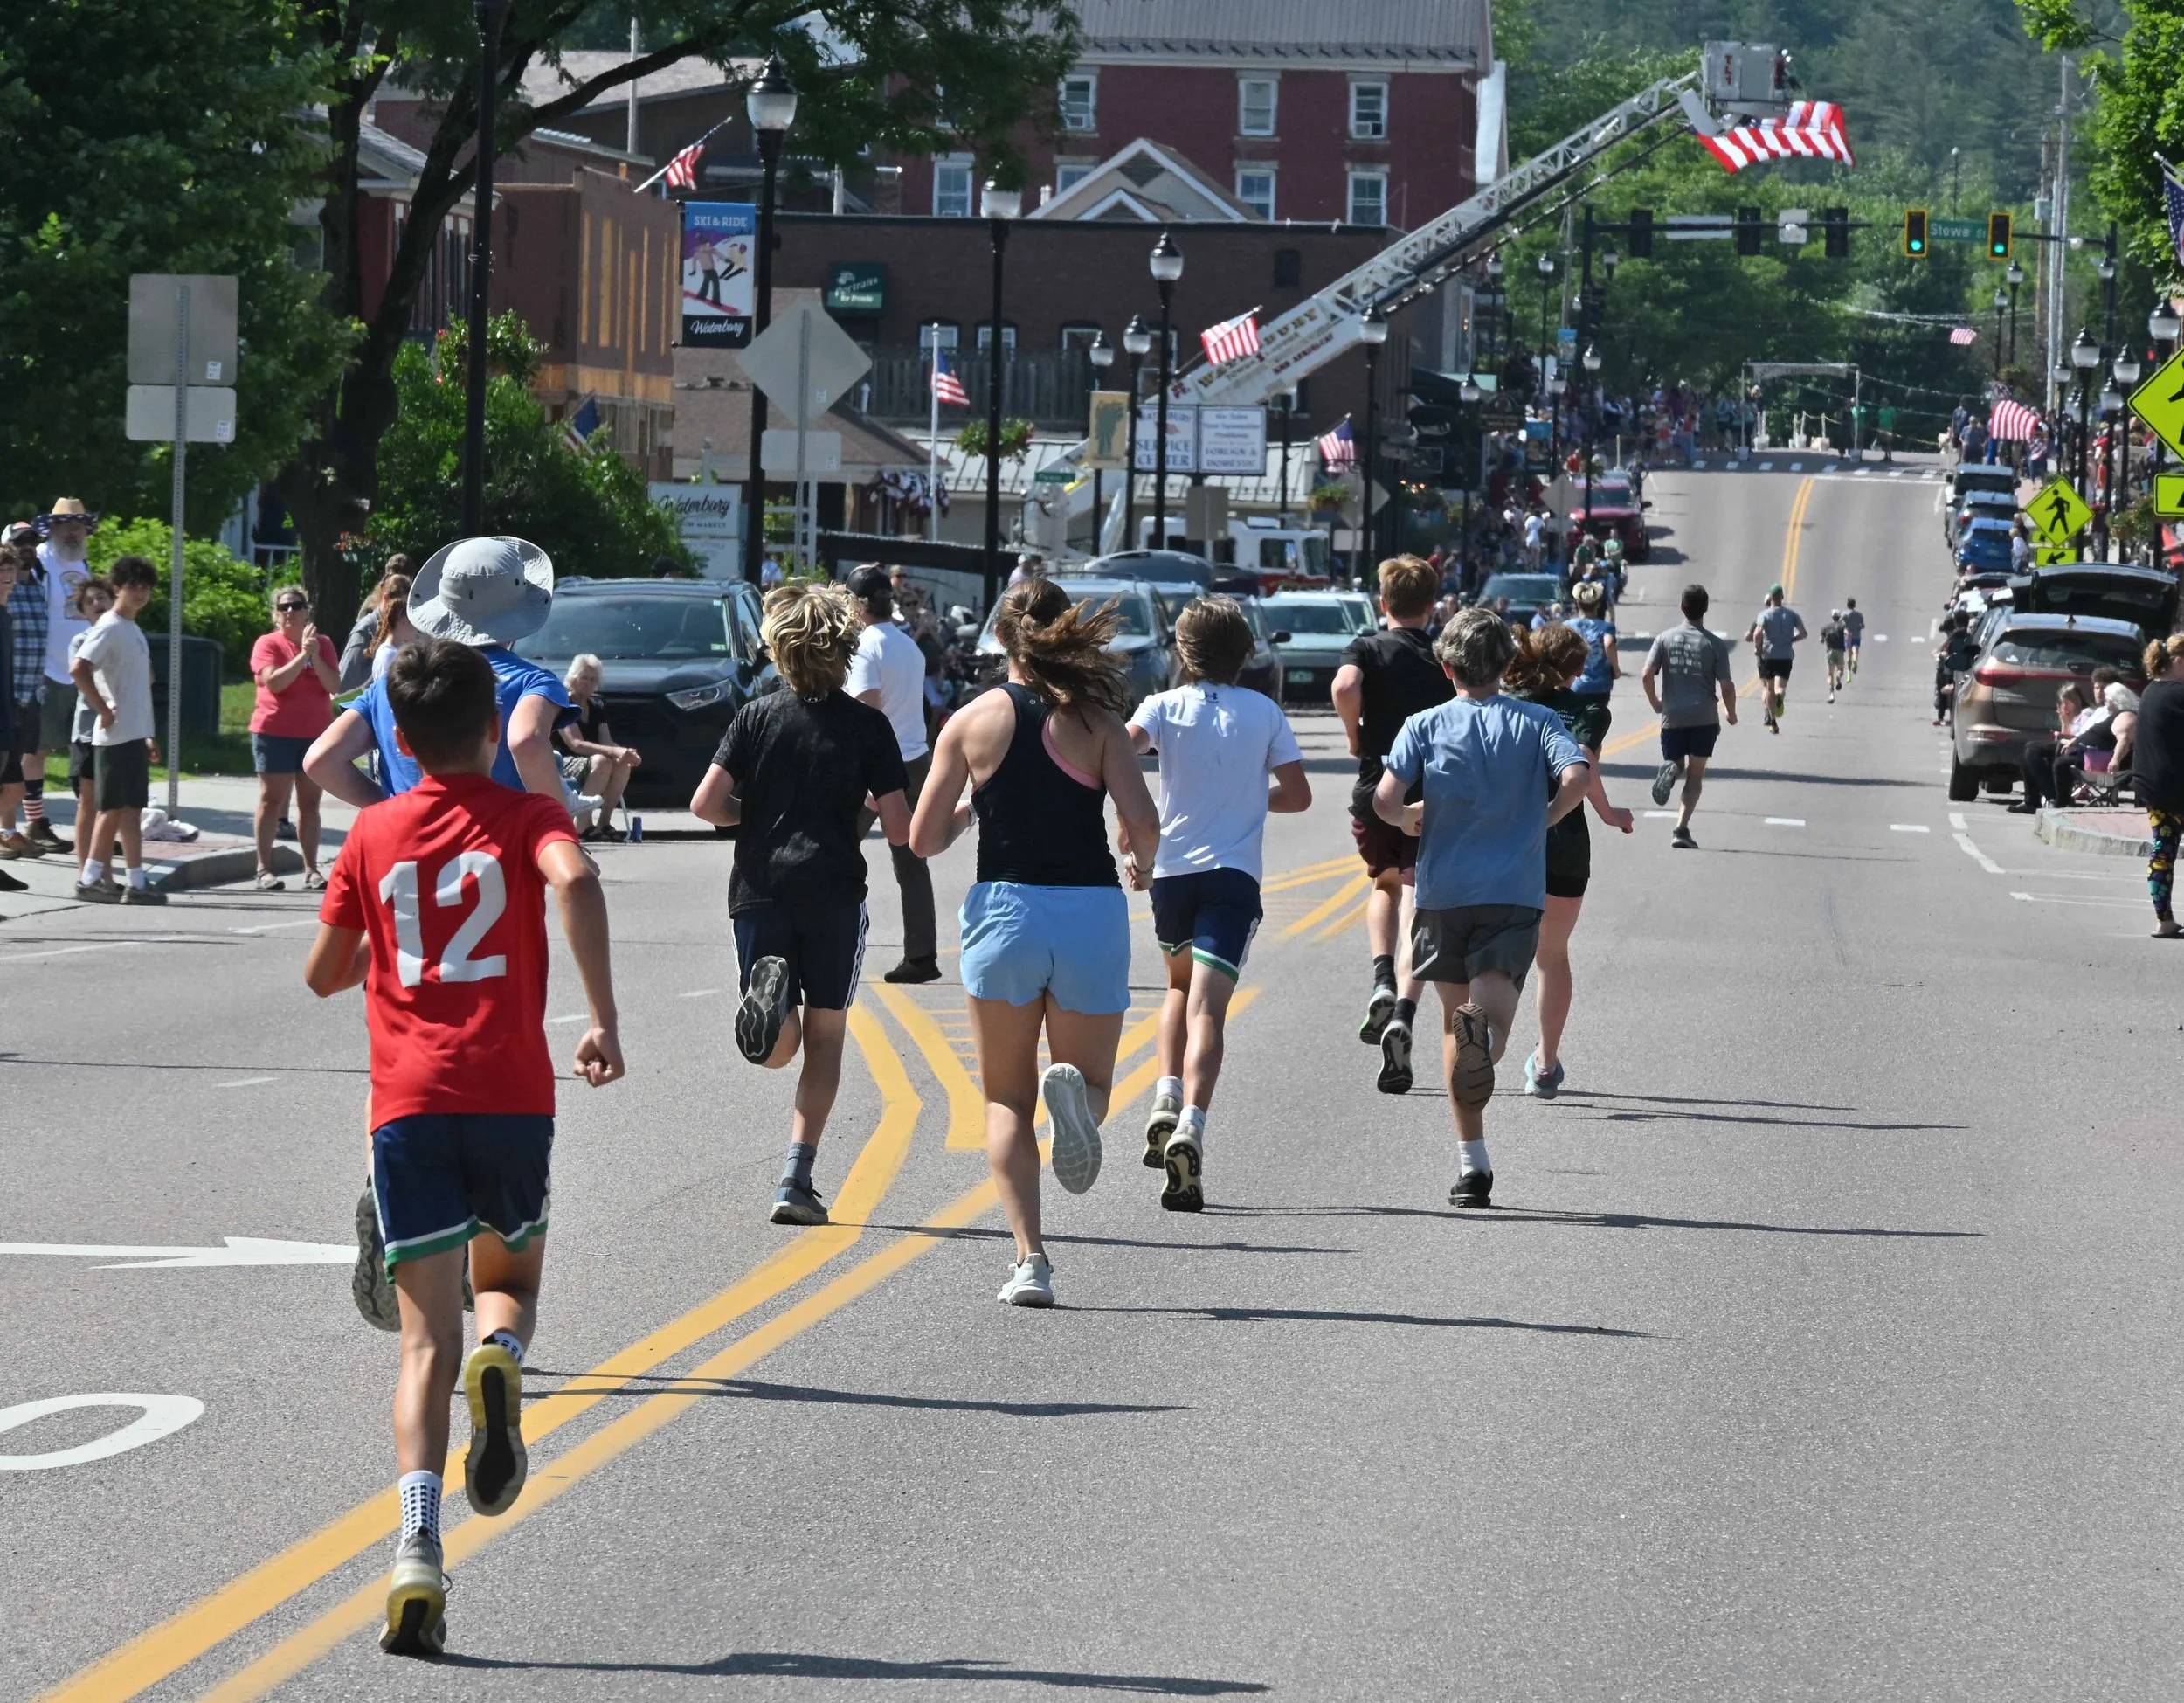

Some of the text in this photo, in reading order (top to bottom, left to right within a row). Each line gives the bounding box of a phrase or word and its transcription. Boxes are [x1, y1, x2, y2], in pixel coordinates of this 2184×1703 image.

[695, 216, 748, 227] SKI & RIDE
[1930, 223, 1970, 237] Stowe
[690, 319, 744, 337] Waterbury
[1135, 440, 1191, 452] SERICE
[1137, 453, 1190, 466] CETER
[379, 851, 507, 988] 12
